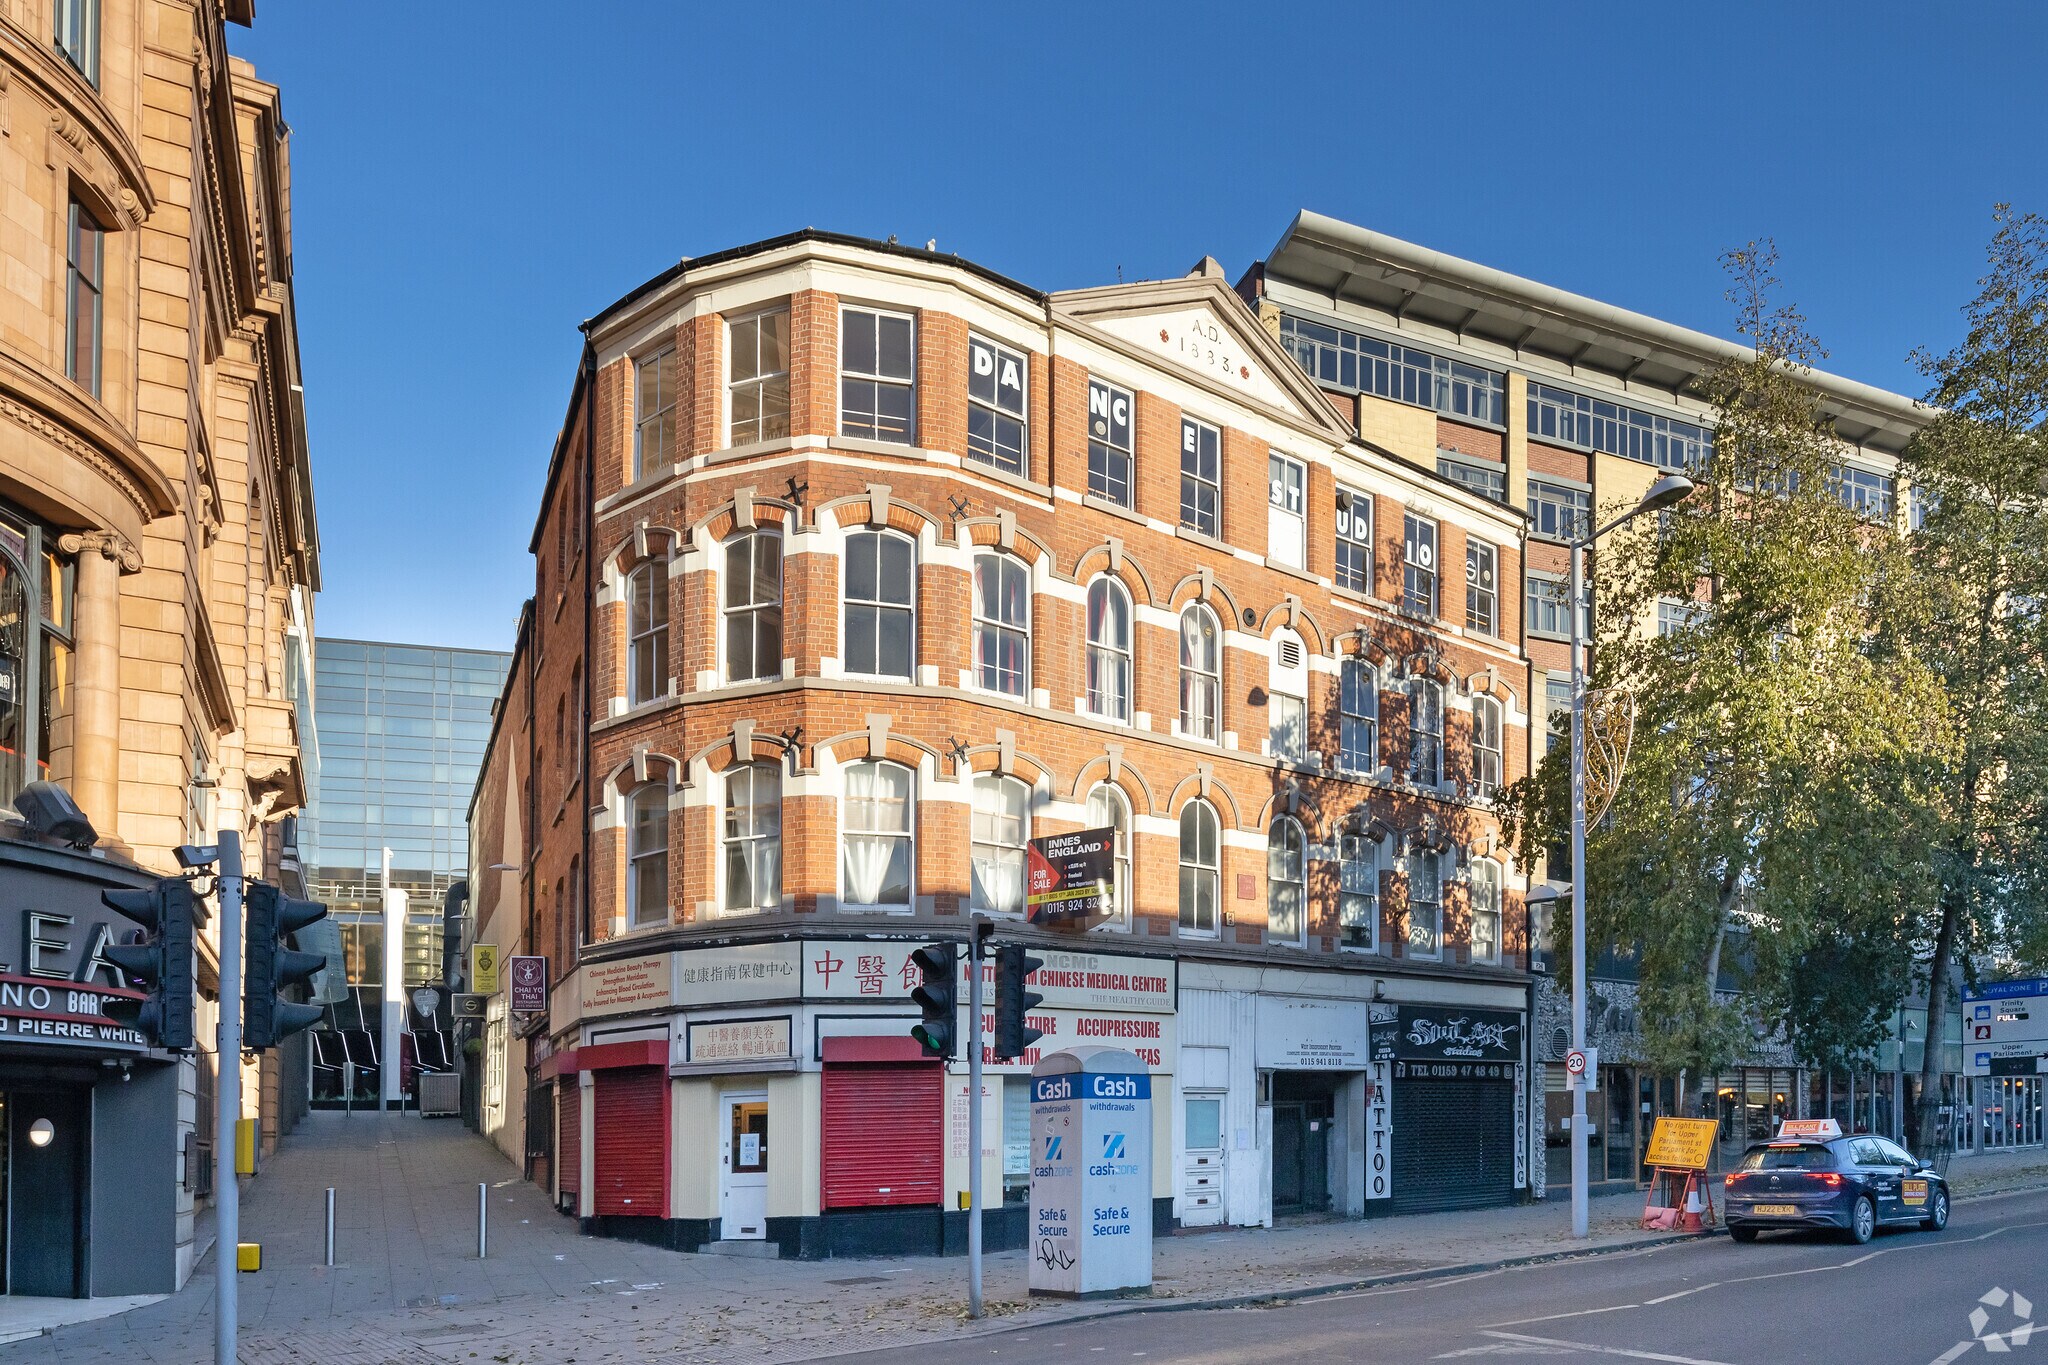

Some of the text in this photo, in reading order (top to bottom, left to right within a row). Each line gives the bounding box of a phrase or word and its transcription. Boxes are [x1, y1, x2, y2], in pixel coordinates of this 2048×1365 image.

[1048, 836, 1081, 849] INNES
[1048, 842, 1101, 859] ENGLAND
[1033, 870, 1047, 880] FOR
[1033, 879, 1051, 890] SALE
[1047, 901, 1065, 914] 0115
[1068, 899, 1083, 911] 924
[1046, 954, 1099, 970] NCMC
[589, 960, 661, 978] Chinese Medicine Beauty Therapy
[602, 973, 648, 986] Strengthen Meridians
[1039, 970, 1085, 988] CHINESE
[1086, 972, 1130, 991] MEDICAL
[1131, 975, 1167, 993] CENTRE
[596, 981, 655, 997] Enhancing Blood Circulation
[2009, 984, 2032, 992] ZONE
[67, 991, 98, 1015] BAR
[583, 1001, 593, 1009] Fully
[617, 995, 636, 1003] Massage
[642, 990, 669, 1000] Acupuncture
[1091, 994, 1107, 1003] THE
[1146, 997, 1171, 1006] GUIDE
[1996, 1014, 2018, 1022] FULL
[18, 1018, 94, 1038] PIERRE
[99, 1026, 143, 1043] WHITE
[1077, 1018, 1160, 1038] ACCUPRESSURE
[1993, 1049, 2032, 1057] Parliament
[1300, 1058, 1342, 1066] 0115 941 8118
[1569, 1058, 1583, 1067] 20
[1411, 1064, 1429, 1076] TEL
[1432, 1065, 1458, 1077] 01159
[1461, 1065, 1471, 1077] 47
[1475, 1065, 1486, 1077] 48
[1488, 1065, 1500, 1077] 49
[1037, 1077, 1071, 1100] Cash
[1093, 1076, 1137, 1097] Cash
[1035, 1103, 1071, 1115] withdrawals
[1089, 1102, 1135, 1112] withdrawals
[1373, 1062, 1386, 1195] TATTOO
[1516, 1063, 1524, 1183] PIERCING
[1822, 1123, 1829, 1131] L
[1659, 1137, 1693, 1146] Parliament
[1672, 1155, 1693, 1163] follow
[1034, 1164, 1073, 1177] cashzone
[1089, 1162, 1139, 1176] cashzone
[1039, 1208, 1067, 1221] Safe &
[1094, 1206, 1129, 1221] Safe &
[1038, 1224, 1068, 1236] Secure
[1093, 1224, 1130, 1236] Secure
